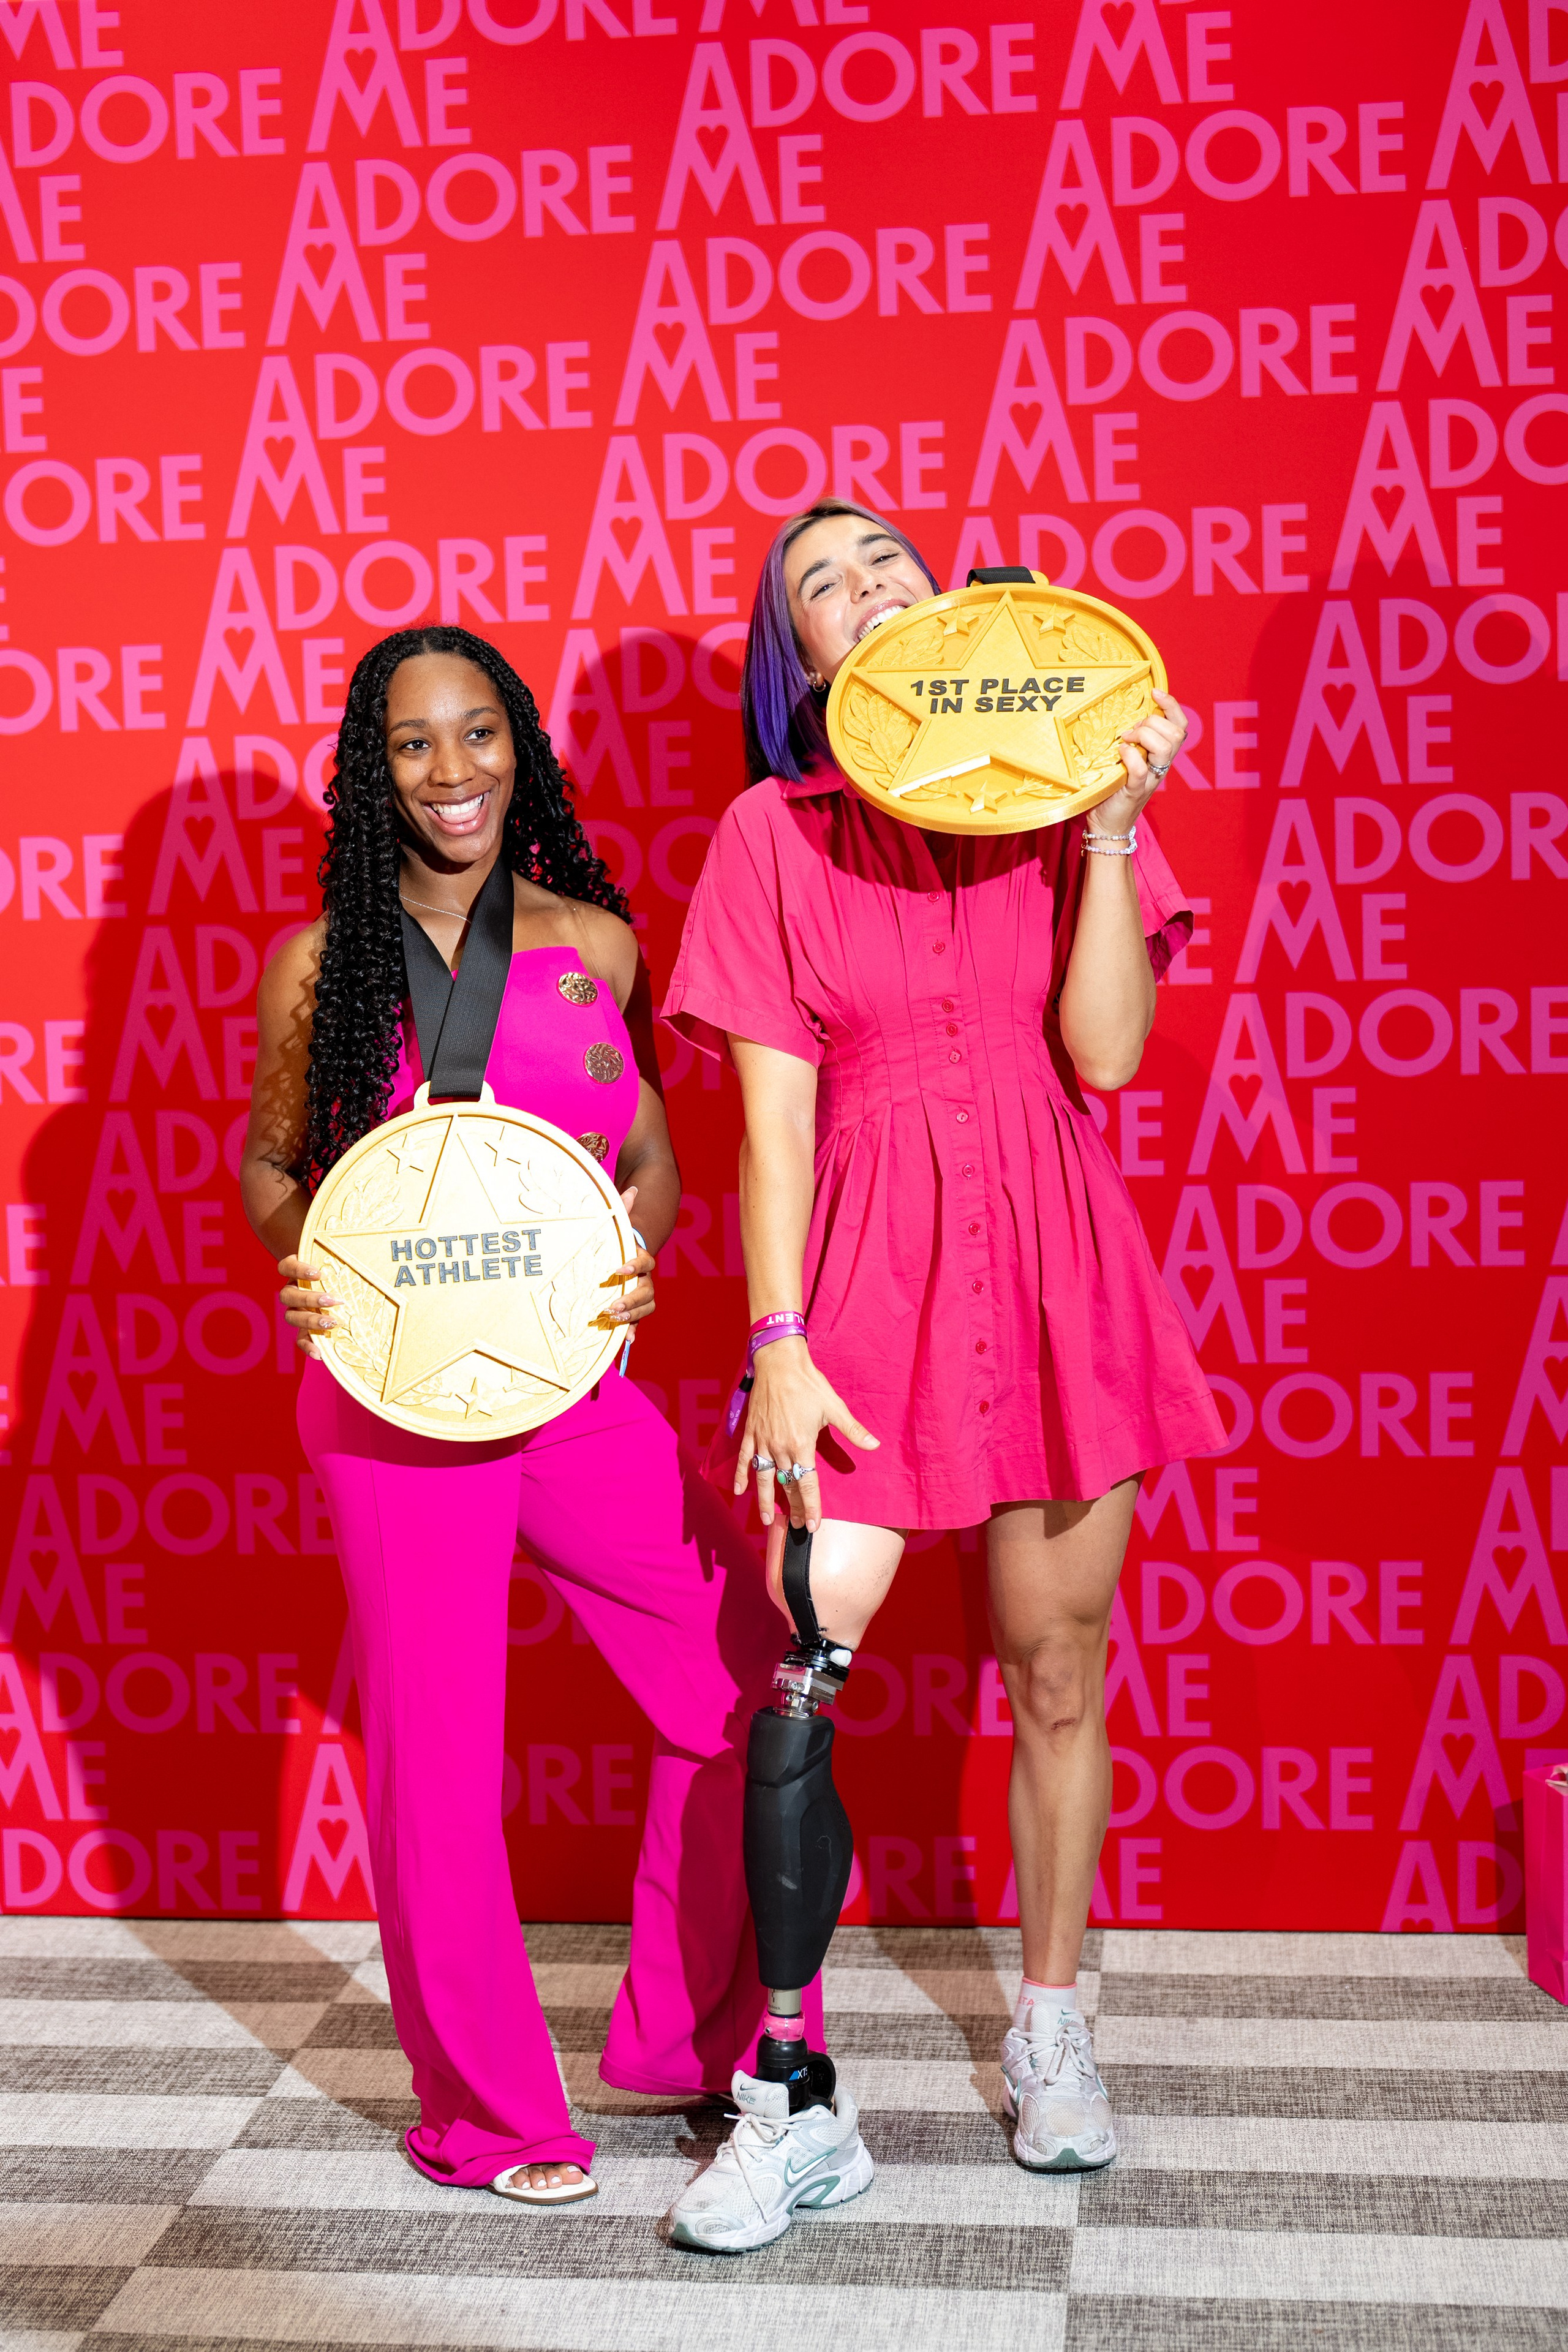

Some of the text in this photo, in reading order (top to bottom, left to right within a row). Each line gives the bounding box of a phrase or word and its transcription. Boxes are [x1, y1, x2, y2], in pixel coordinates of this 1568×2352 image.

[306, 50, 473, 153] ME
[679, 21, 1041, 128] ADORE
[1060, 5, 1237, 110] ME
[0, 66, 288, 169] DORE
[1038, 100, 1408, 207] ADORE
[286, 143, 637, 247] ADORE
[656, 128, 827, 231] ME
[265, 247, 431, 347] ME
[635, 223, 993, 326] ADORE
[1013, 207, 1188, 311] ME
[612, 326, 782, 427] ME
[990, 304, 1358, 407] ADORE
[1378, 288, 1558, 393] ME
[245, 341, 593, 440] ADORE
[224, 440, 389, 539] ME
[590, 421, 947, 521] ADORE
[966, 406, 1140, 508] ME
[1354, 393, 1568, 489] ADO
[2, 454, 206, 549] ORE
[1329, 489, 1507, 592] ME
[205, 535, 549, 632] ADORE
[568, 521, 737, 620] ME
[184, 631, 347, 729] ME
[547, 622, 748, 712] ADO
[911, 677, 1085, 696] 1ST PLACE
[1305, 592, 1568, 688] ADO
[930, 695, 1061, 714] IN SEXY
[1279, 687, 1456, 789] ME
[547, 709, 695, 809] ME
[144, 820, 306, 916] ME
[1256, 790, 1568, 884] ADOR
[1231, 883, 1406, 983] ME
[104, 1006, 265, 1101] ME
[1208, 985, 1568, 1079] ADORE
[1183, 1076, 1357, 1175] ME
[66, 1189, 225, 1284] ME
[391, 1229, 541, 1261] HOTTEST
[394, 1255, 543, 1287] ATHLETE
[1160, 1179, 1525, 1270] ADORE
[45, 1290, 299, 1374] ADO
[27, 1371, 186, 1464] ME
[1194, 1372, 1475, 1459] DORE
[0, 1551, 146, 1644] ME
[1109, 1559, 1425, 1645] DORE
[1110, 1746, 1374, 1830] DORE
[0, 1828, 260, 1911] DORE
[736, 2091, 756, 2105] NIKE
